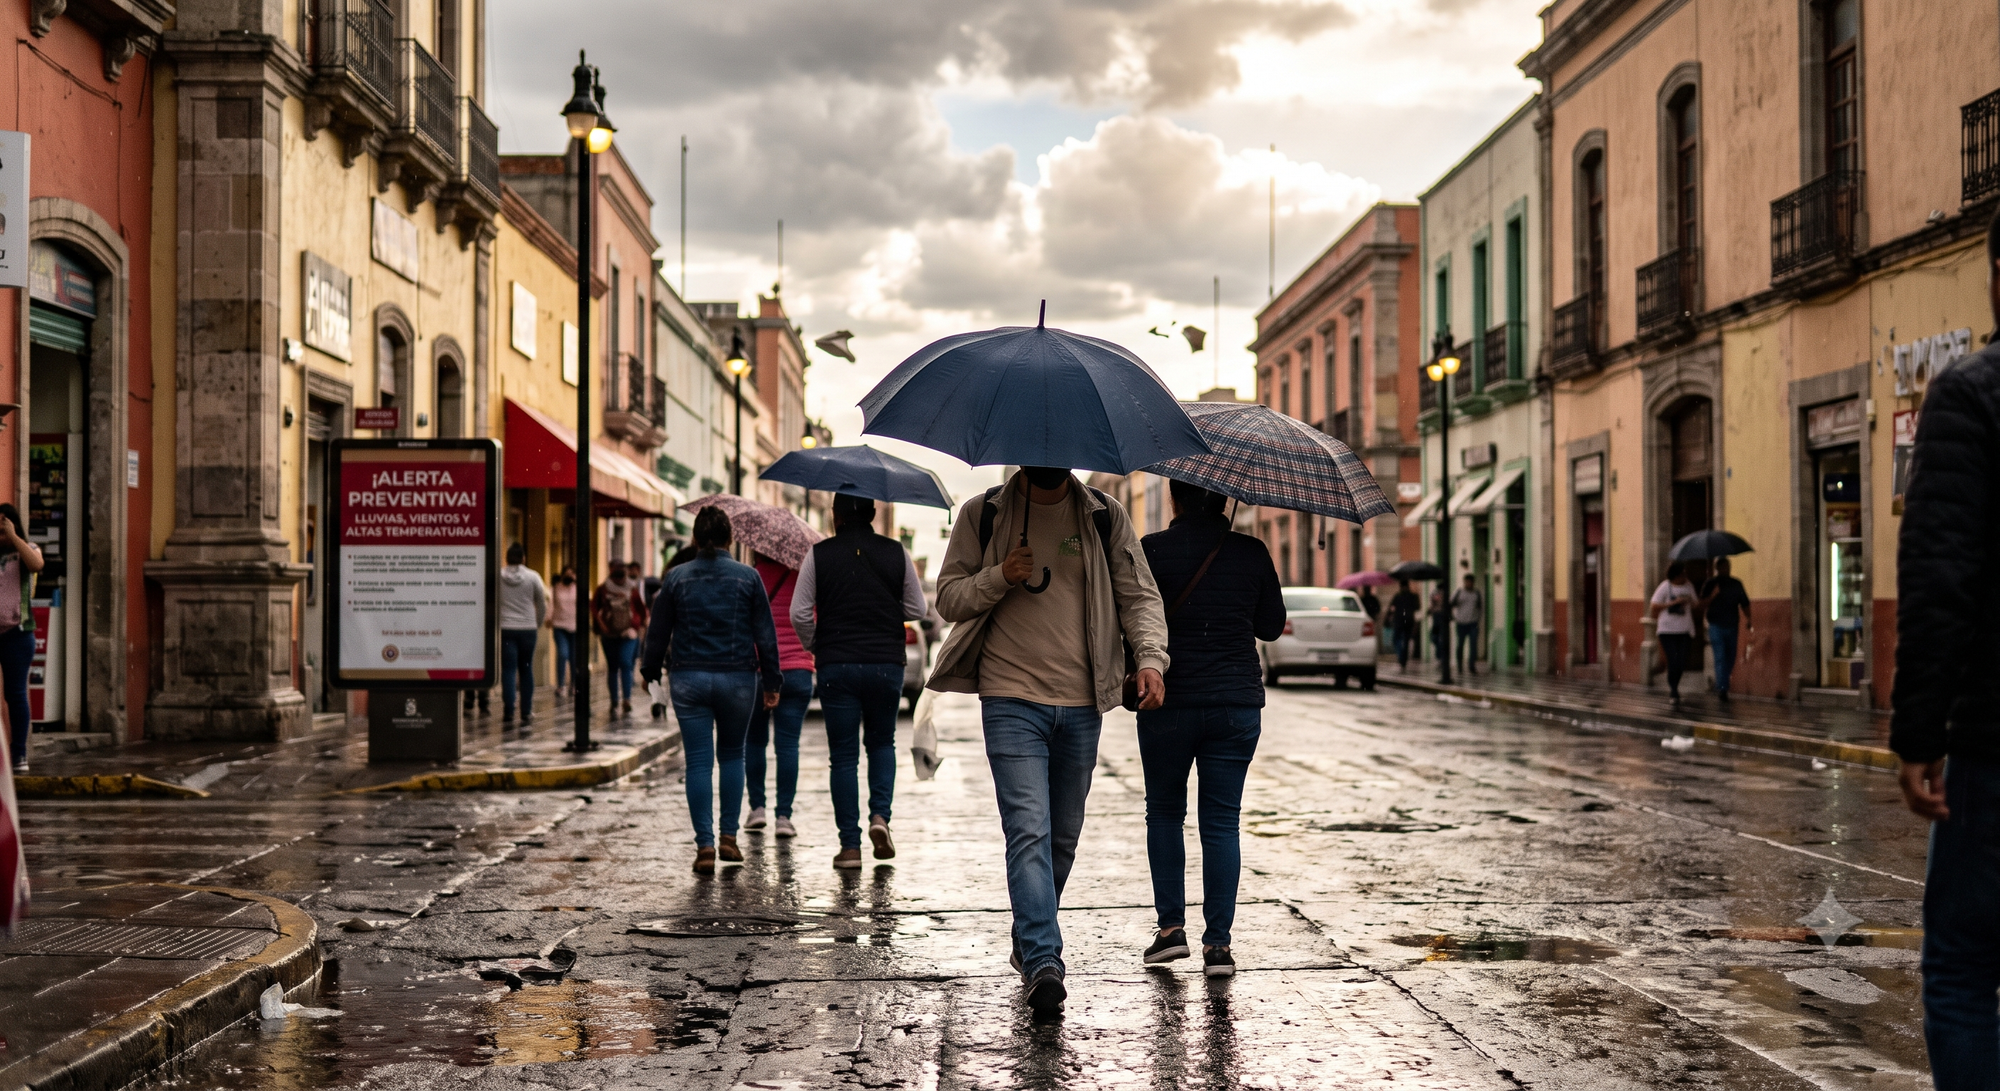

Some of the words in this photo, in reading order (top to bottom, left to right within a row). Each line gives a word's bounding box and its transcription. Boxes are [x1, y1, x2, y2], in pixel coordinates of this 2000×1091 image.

[372, 470, 454, 489] ¡ALERTA
[348, 491, 477, 507] PREVENTIVA!
[355, 513, 407, 525] LLUVIAS,
[409, 513, 460, 524] VIENTOS
[462, 513, 470, 524] Y
[345, 526, 382, 537] ALTAS
[384, 526, 480, 537] TEMPERATURAS
